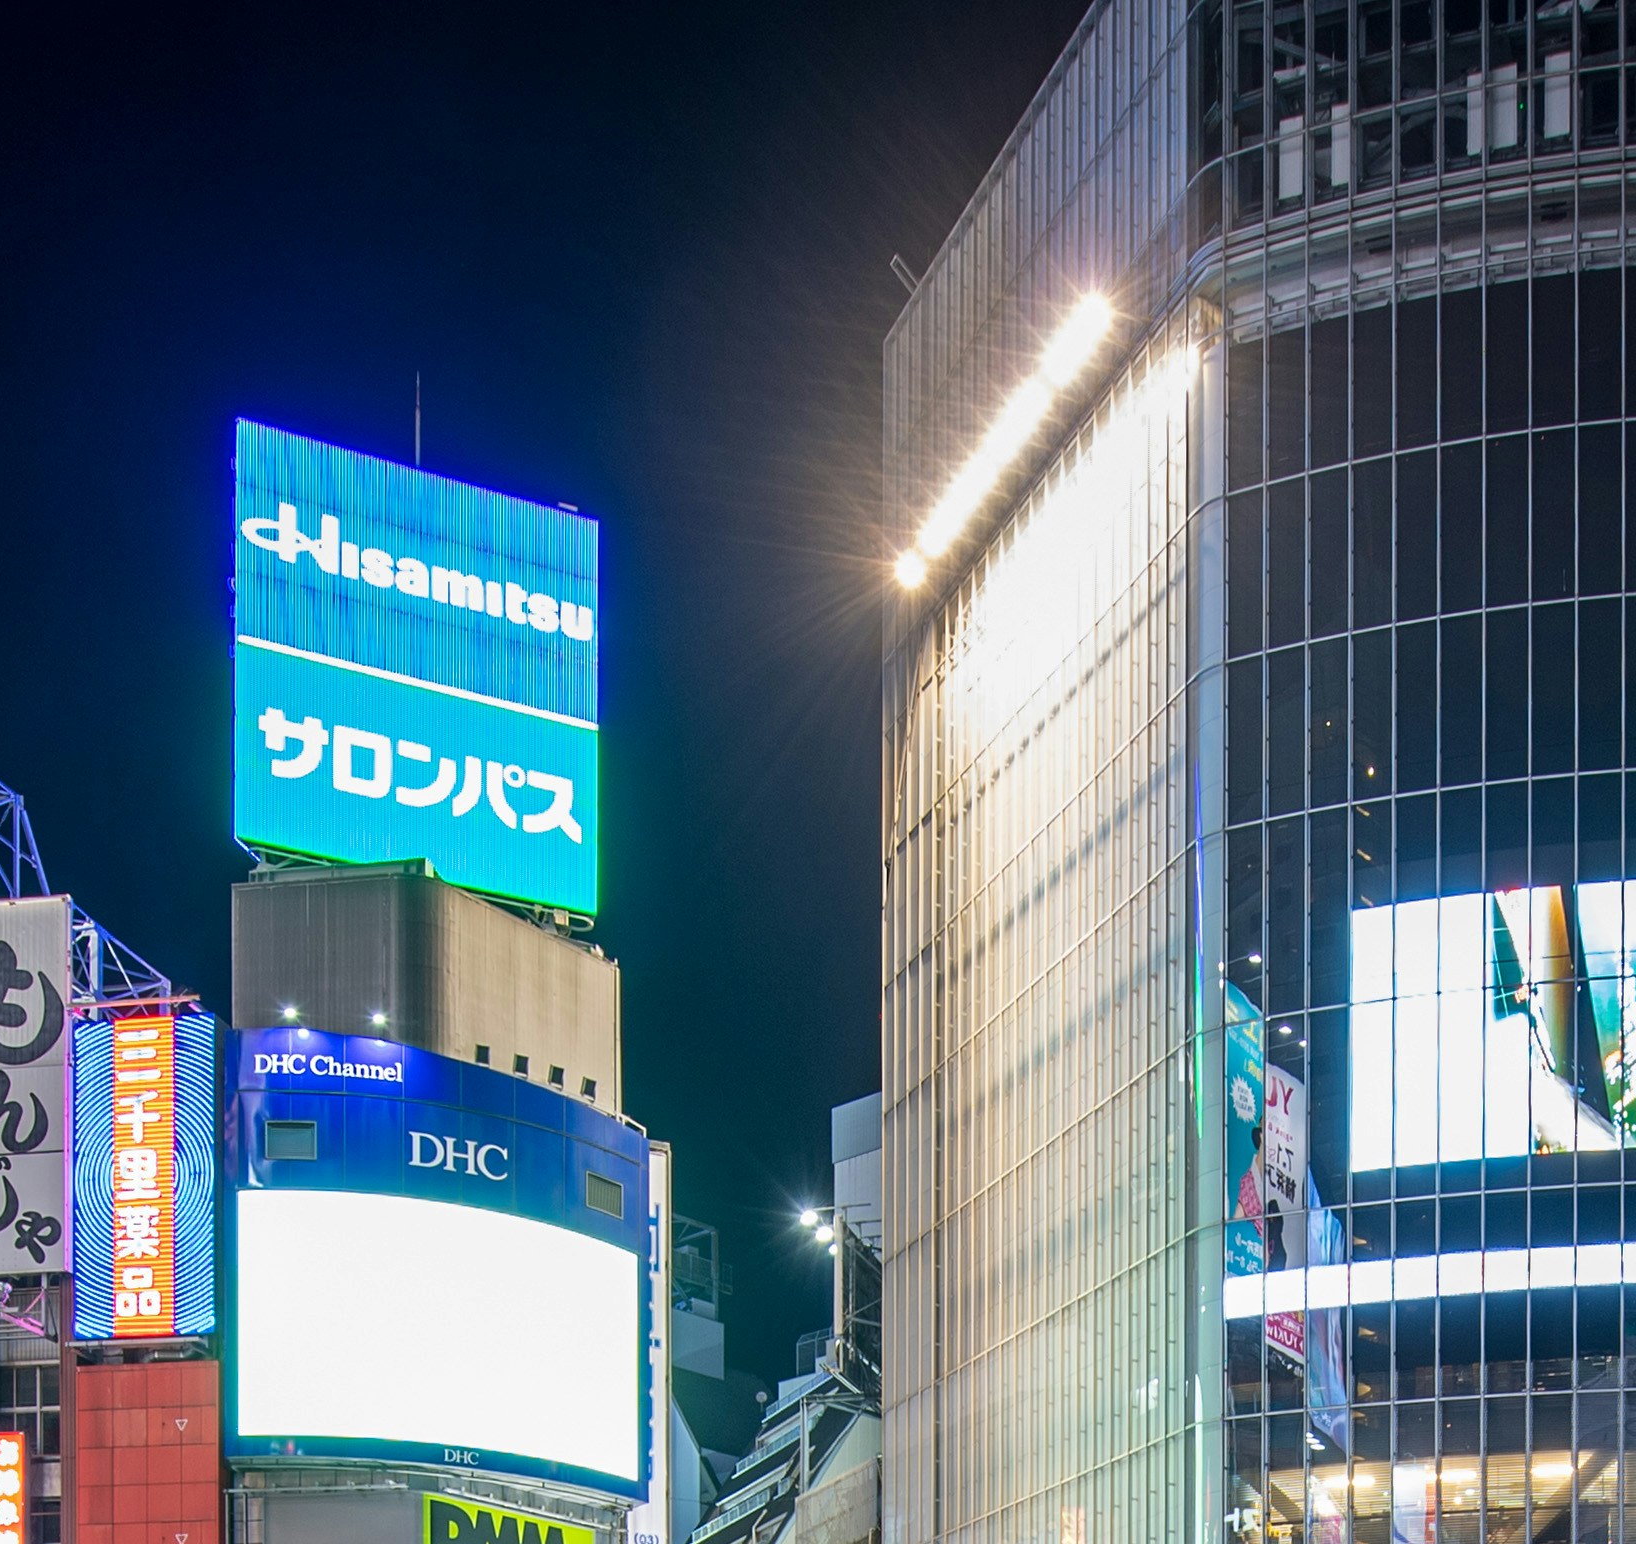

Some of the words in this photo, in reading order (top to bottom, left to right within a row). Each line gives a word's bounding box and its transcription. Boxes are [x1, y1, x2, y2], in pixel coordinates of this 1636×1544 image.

[240, 501, 594, 642] Hisamitsu
[258, 706, 583, 845] サロンパス
[253, 1053, 306, 1076] DHC
[309, 1053, 404, 1084] Channel
[115, 1028, 163, 1318] 三千里薬品
[407, 1130, 509, 1182] DHC
[443, 1448, 480, 1466] DHC
